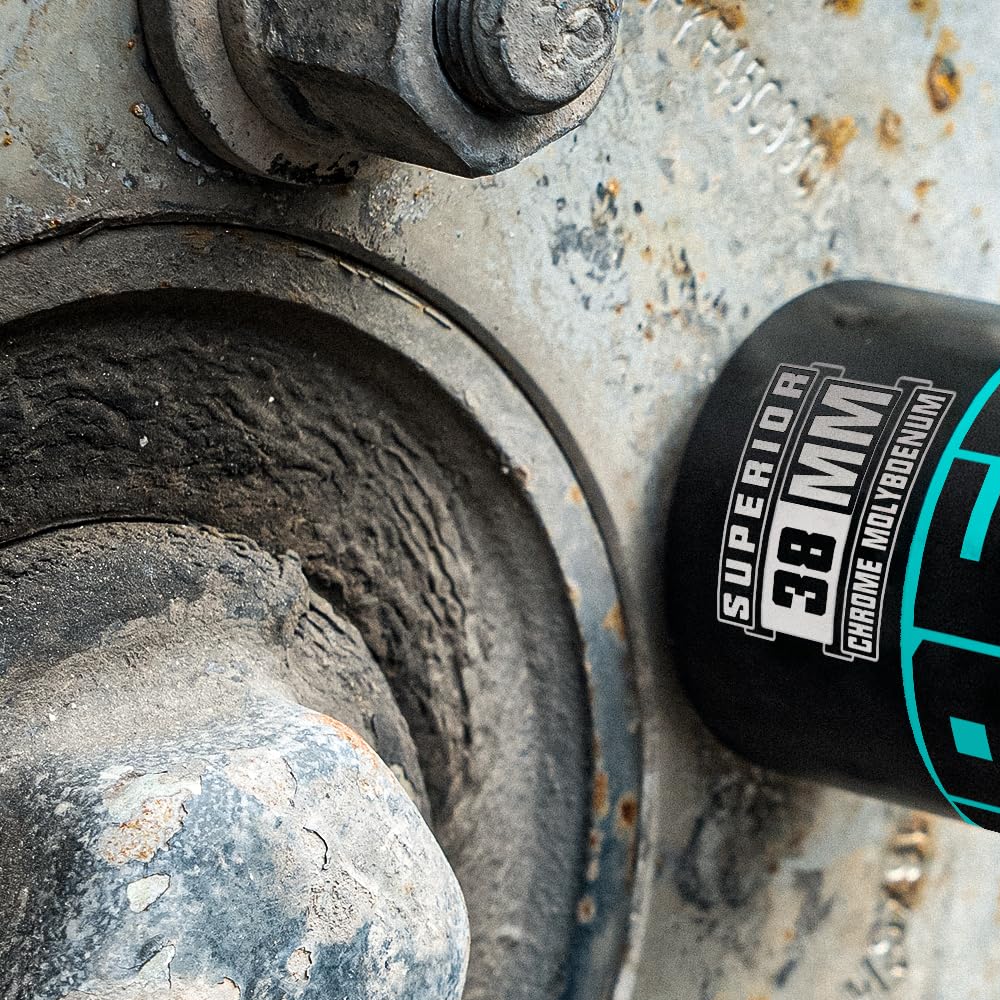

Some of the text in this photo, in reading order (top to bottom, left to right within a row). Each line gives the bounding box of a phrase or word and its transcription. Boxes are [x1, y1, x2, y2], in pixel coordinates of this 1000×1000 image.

[722, 370, 810, 621] SUPERIOR
[771, 382, 894, 617] 38 MM
[847, 390, 946, 654] CHROME MOLYBDENUM
